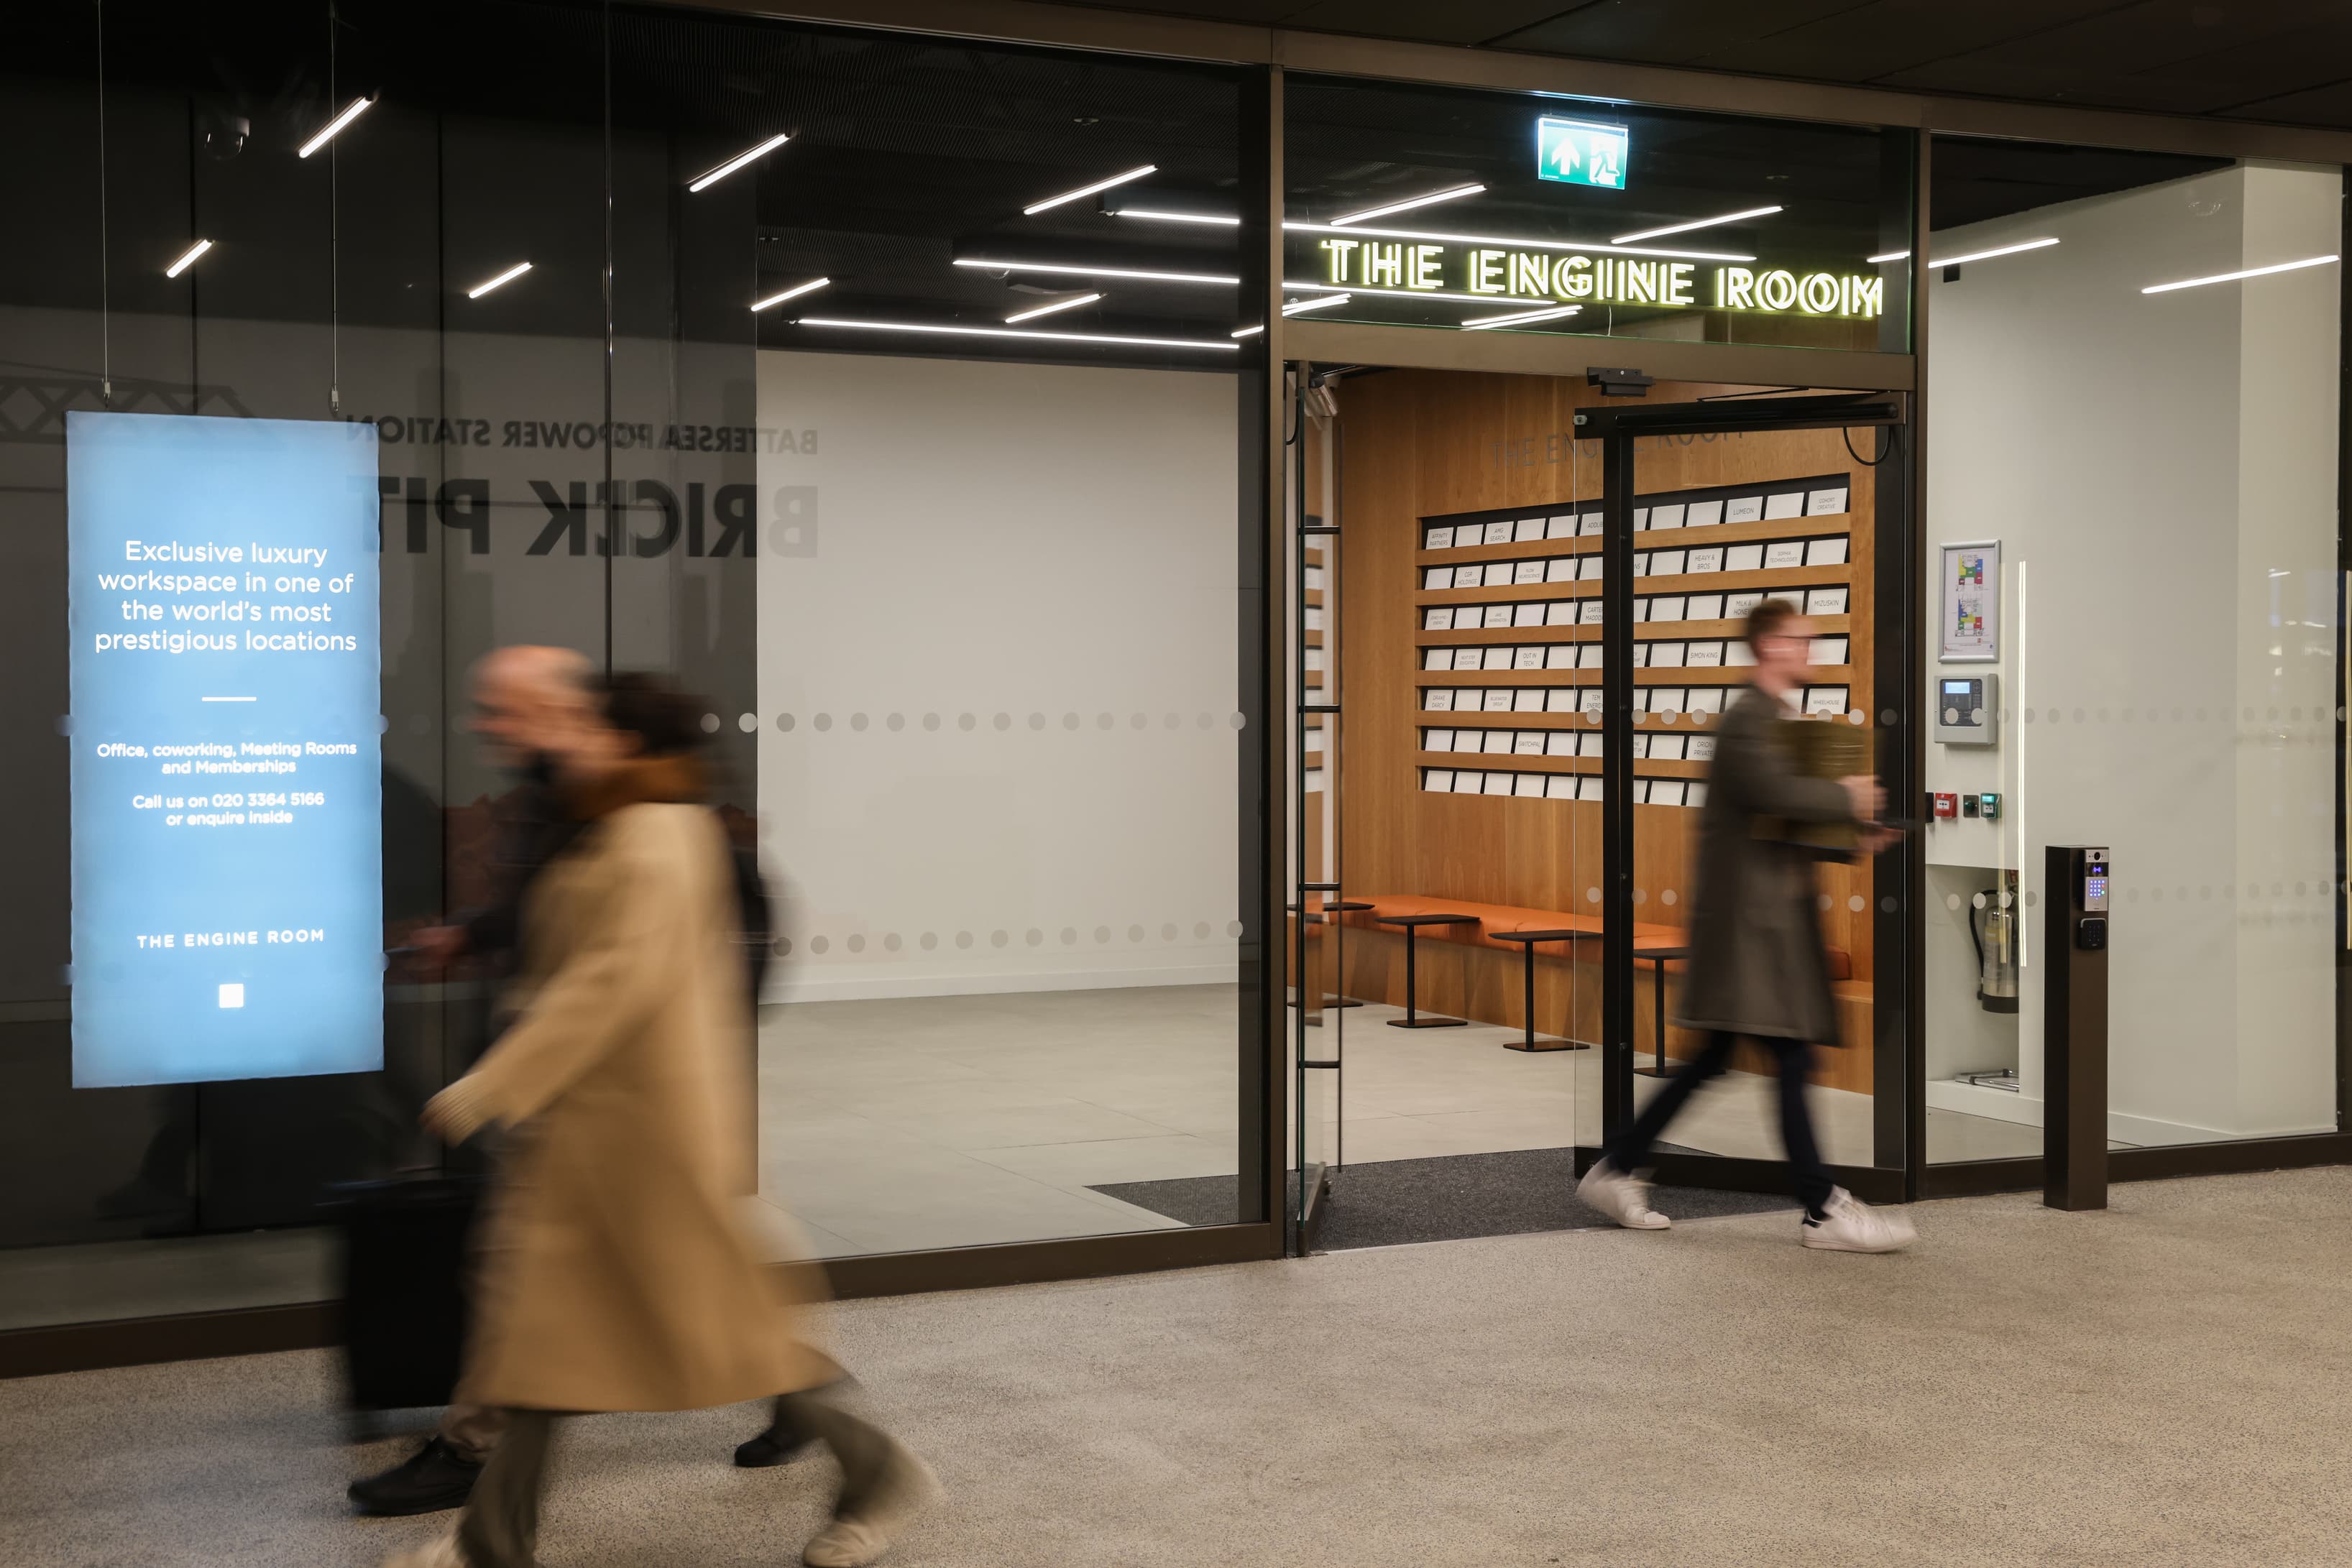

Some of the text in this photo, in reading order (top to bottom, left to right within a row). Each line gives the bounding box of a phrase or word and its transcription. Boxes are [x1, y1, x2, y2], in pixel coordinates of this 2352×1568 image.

[1324, 239, 1883, 317] THE ENGINE ROOM
[1733, 507, 1754, 516] LUMEON
[126, 540, 328, 568] Exclusive luxury
[98, 571, 354, 594] workspace in one of
[121, 600, 332, 622] the world's most
[96, 630, 357, 653] prestigious locations
[97, 742, 357, 759] Office, coworking, Meeting Rooms
[162, 759, 296, 775] and Memberships
[133, 792, 325, 809] Call us on 020 3364 5166
[165, 810, 293, 827] or enquire inside
[137, 928, 324, 949] THE ENGINE ROOM
